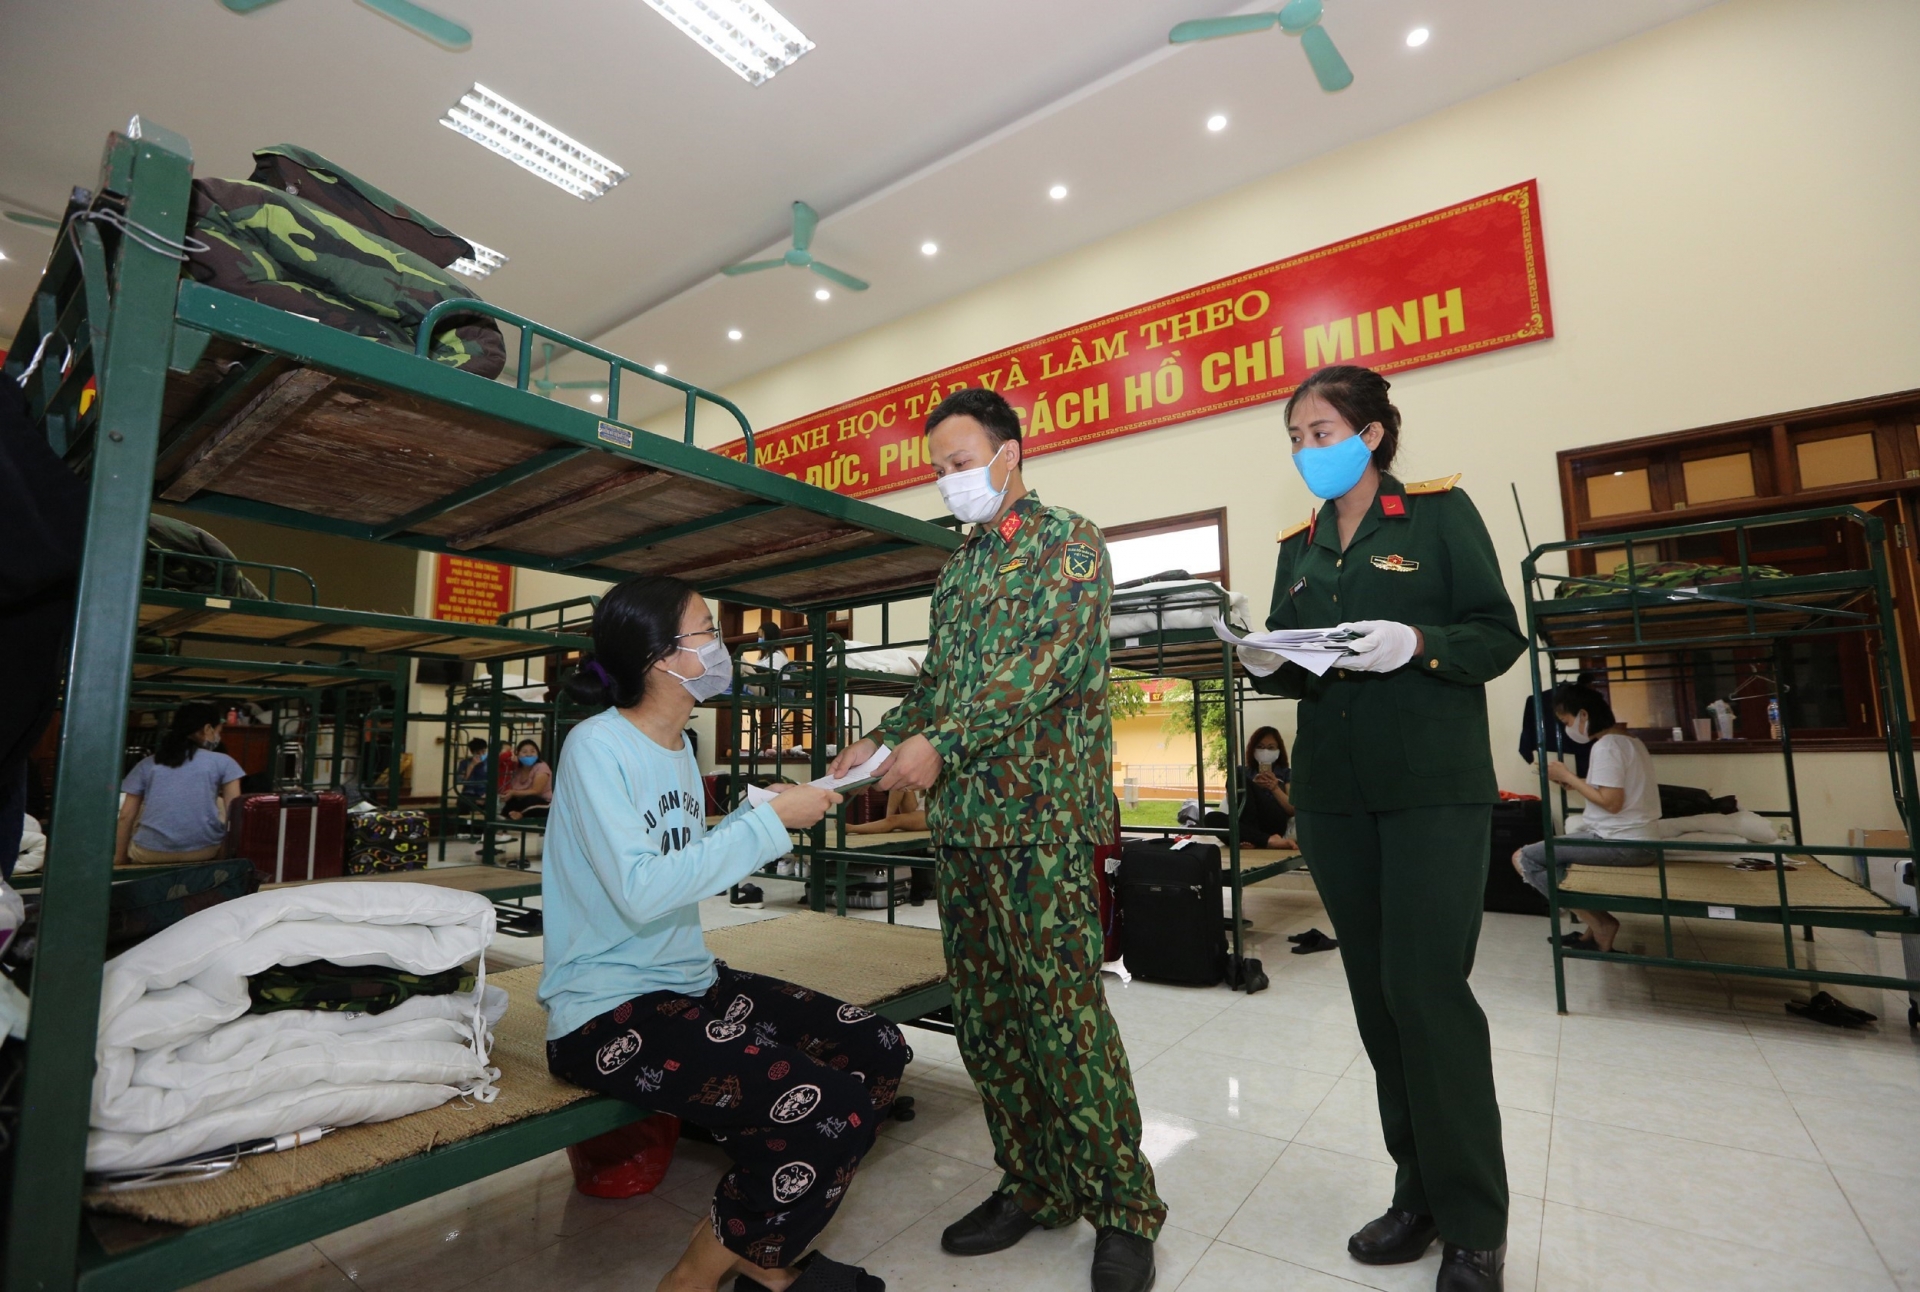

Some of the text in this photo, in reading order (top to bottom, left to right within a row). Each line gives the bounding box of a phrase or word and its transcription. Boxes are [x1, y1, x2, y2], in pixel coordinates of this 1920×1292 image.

[754, 426, 830, 467] MẠNH
[837, 403, 897, 441] HỌC
[977, 356, 1029, 392] VÀ
[1039, 330, 1129, 380] LÀM
[1140, 289, 1270, 350] THEO
[1124, 350, 1184, 414] HỒ
[1201, 325, 1285, 394] CHÍ
[1303, 287, 1465, 370] MINH
